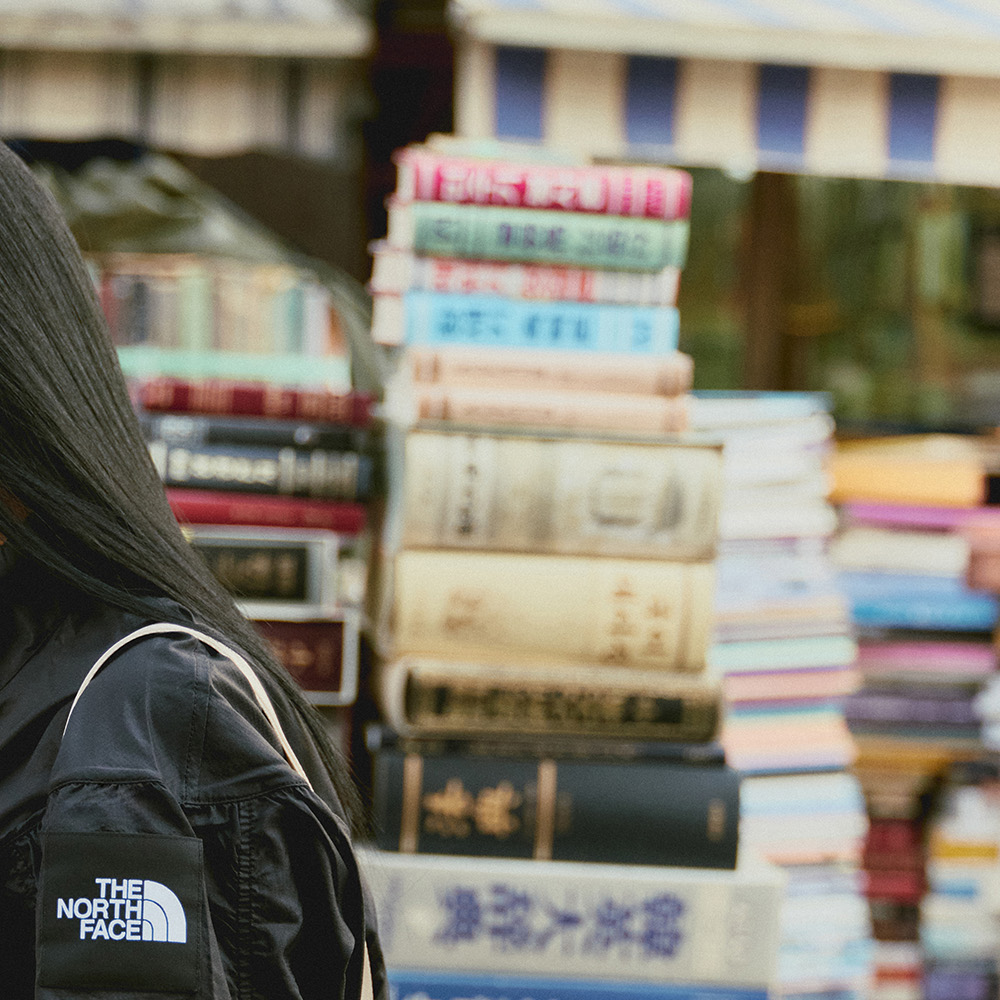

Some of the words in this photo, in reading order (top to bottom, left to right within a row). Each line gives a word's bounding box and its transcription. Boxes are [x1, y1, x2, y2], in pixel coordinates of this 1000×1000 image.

[95, 878, 143, 899] THE
[56, 898, 142, 919] NORTH
[80, 918, 142, 940] FACE
